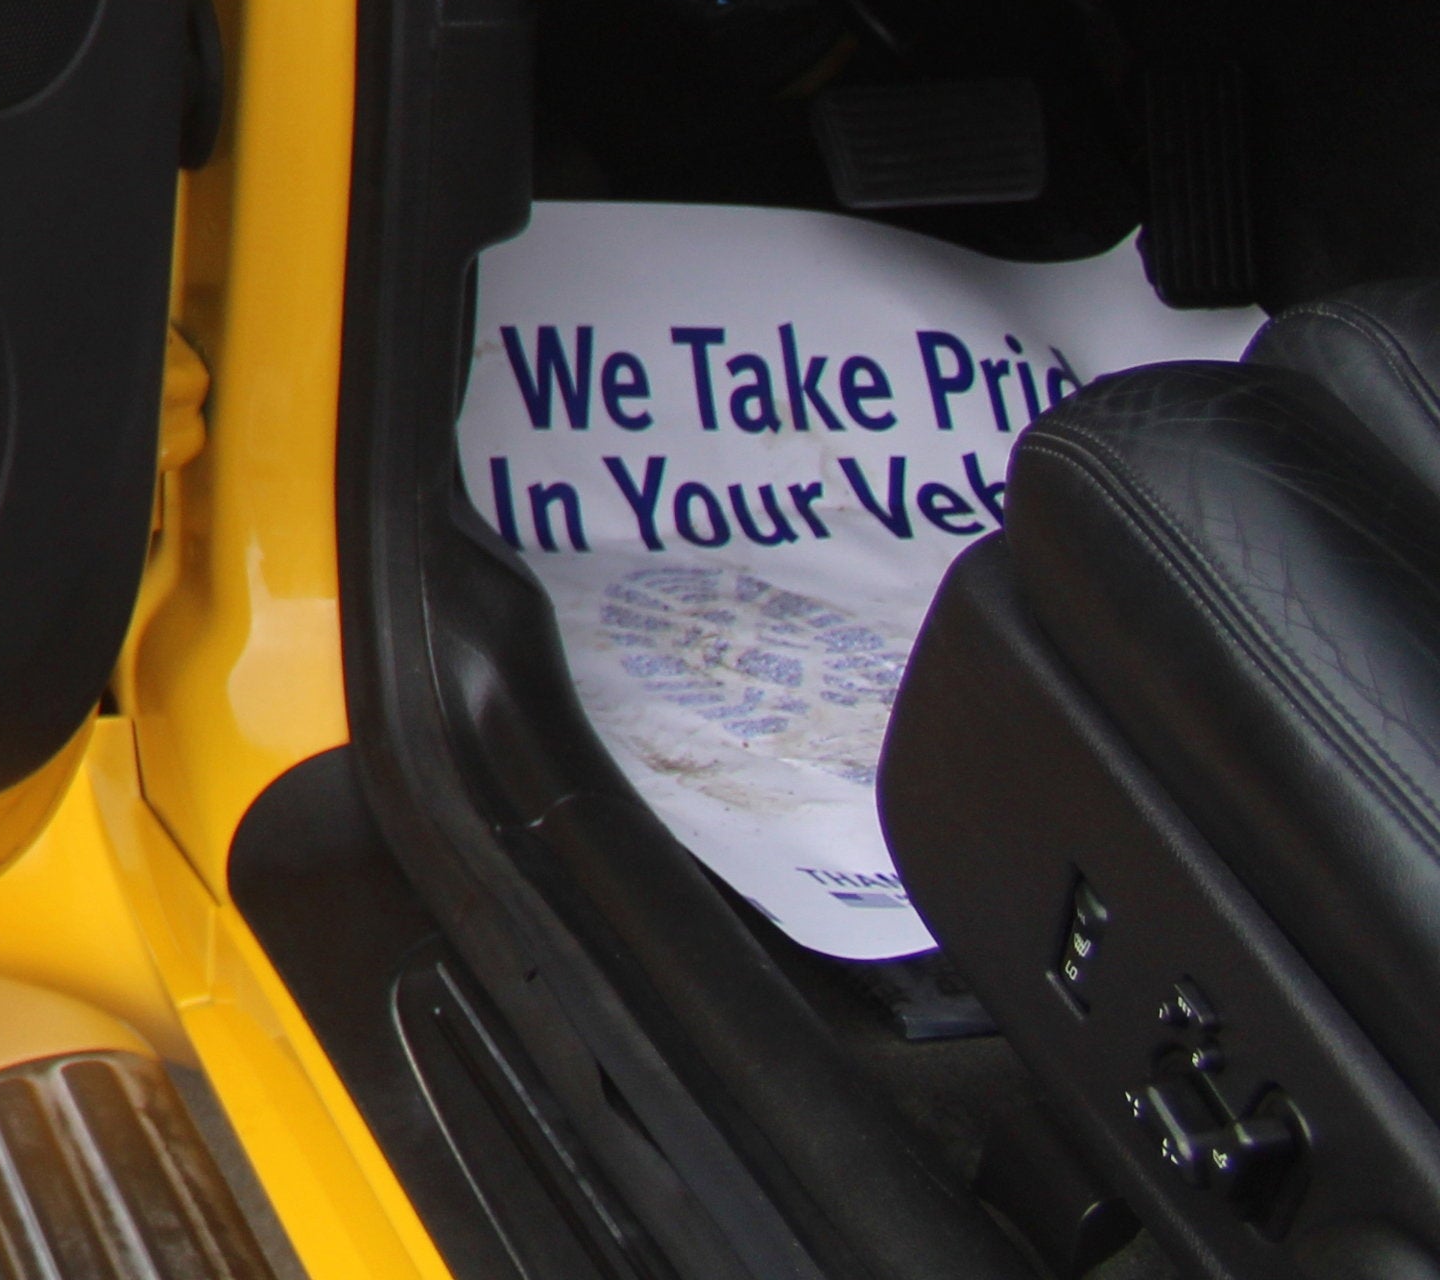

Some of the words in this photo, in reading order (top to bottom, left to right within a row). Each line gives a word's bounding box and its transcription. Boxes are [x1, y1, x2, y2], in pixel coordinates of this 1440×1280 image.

[499, 326, 654, 432] We
[670, 322, 898, 434] Take
[490, 456, 591, 552] In
[602, 455, 831, 552] Your
